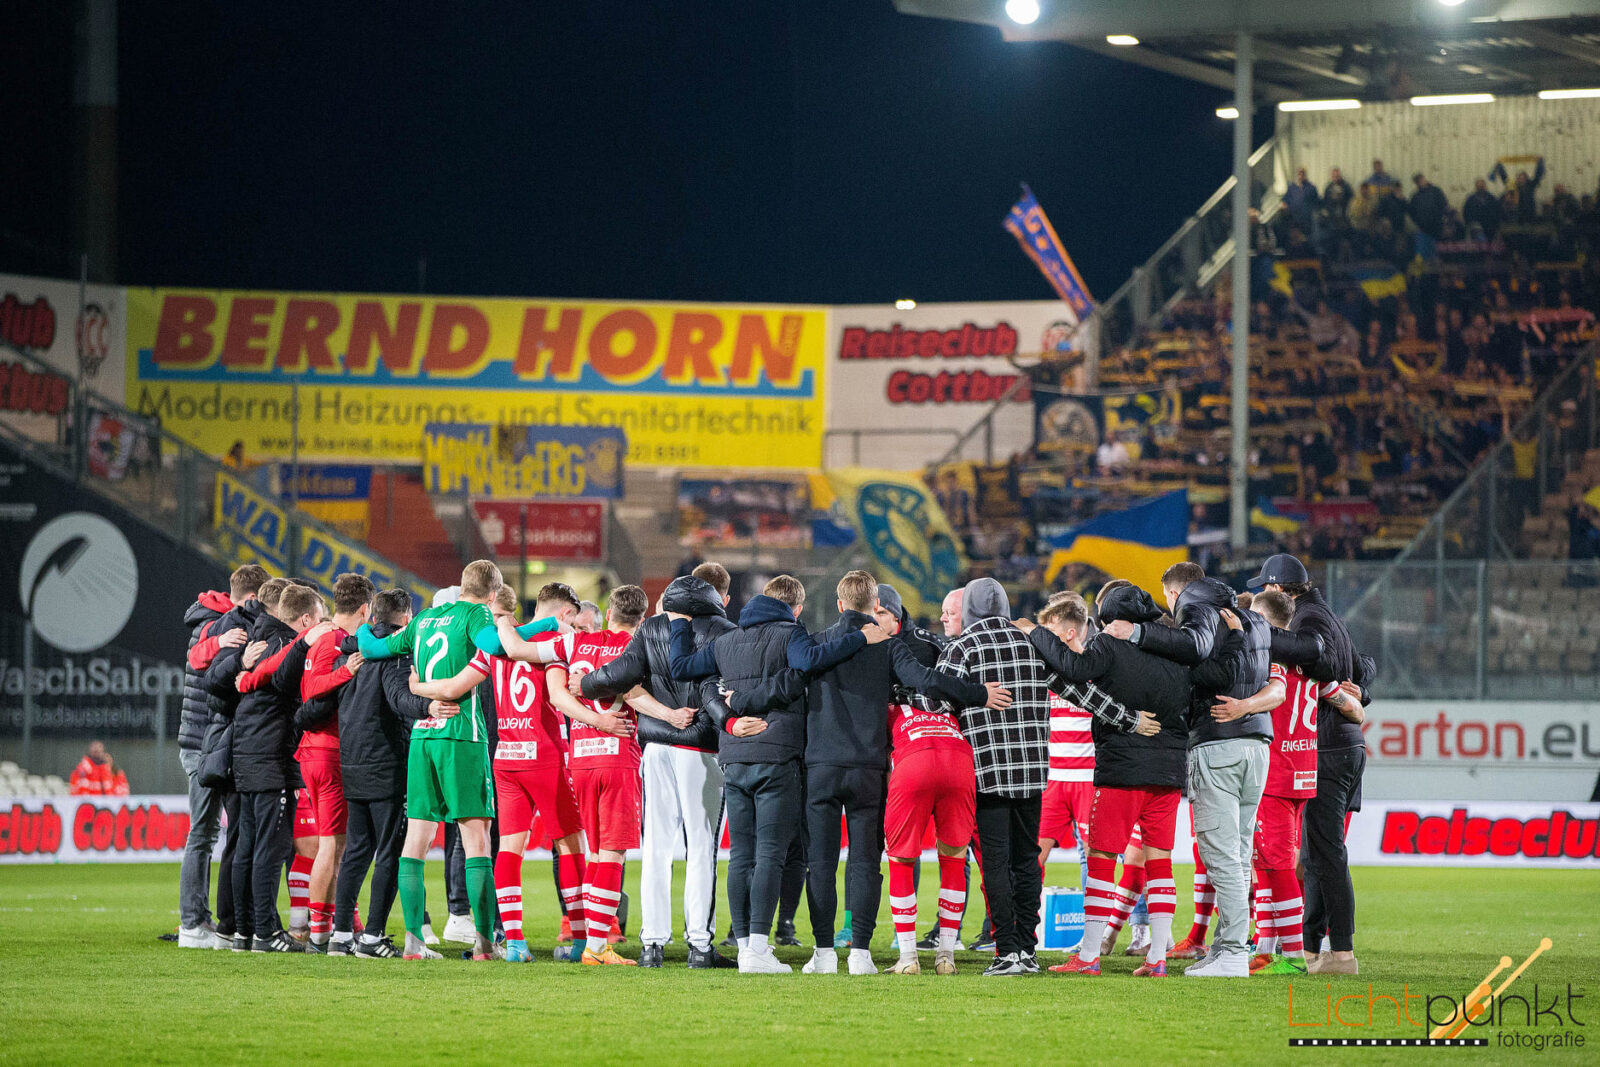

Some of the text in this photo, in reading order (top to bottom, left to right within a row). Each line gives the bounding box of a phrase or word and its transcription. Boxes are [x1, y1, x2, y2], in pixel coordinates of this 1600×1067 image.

[151, 294, 490, 374] BERND
[513, 307, 804, 383] HORN
[838, 322, 1018, 360] Reiseclub
[137, 384, 302, 421] Moderne
[500, 396, 564, 426] und
[414, 631, 449, 684] 12
[495, 659, 536, 713] 16
[1288, 678, 1319, 735] 18
[940, 901, 960, 911] JAKO
